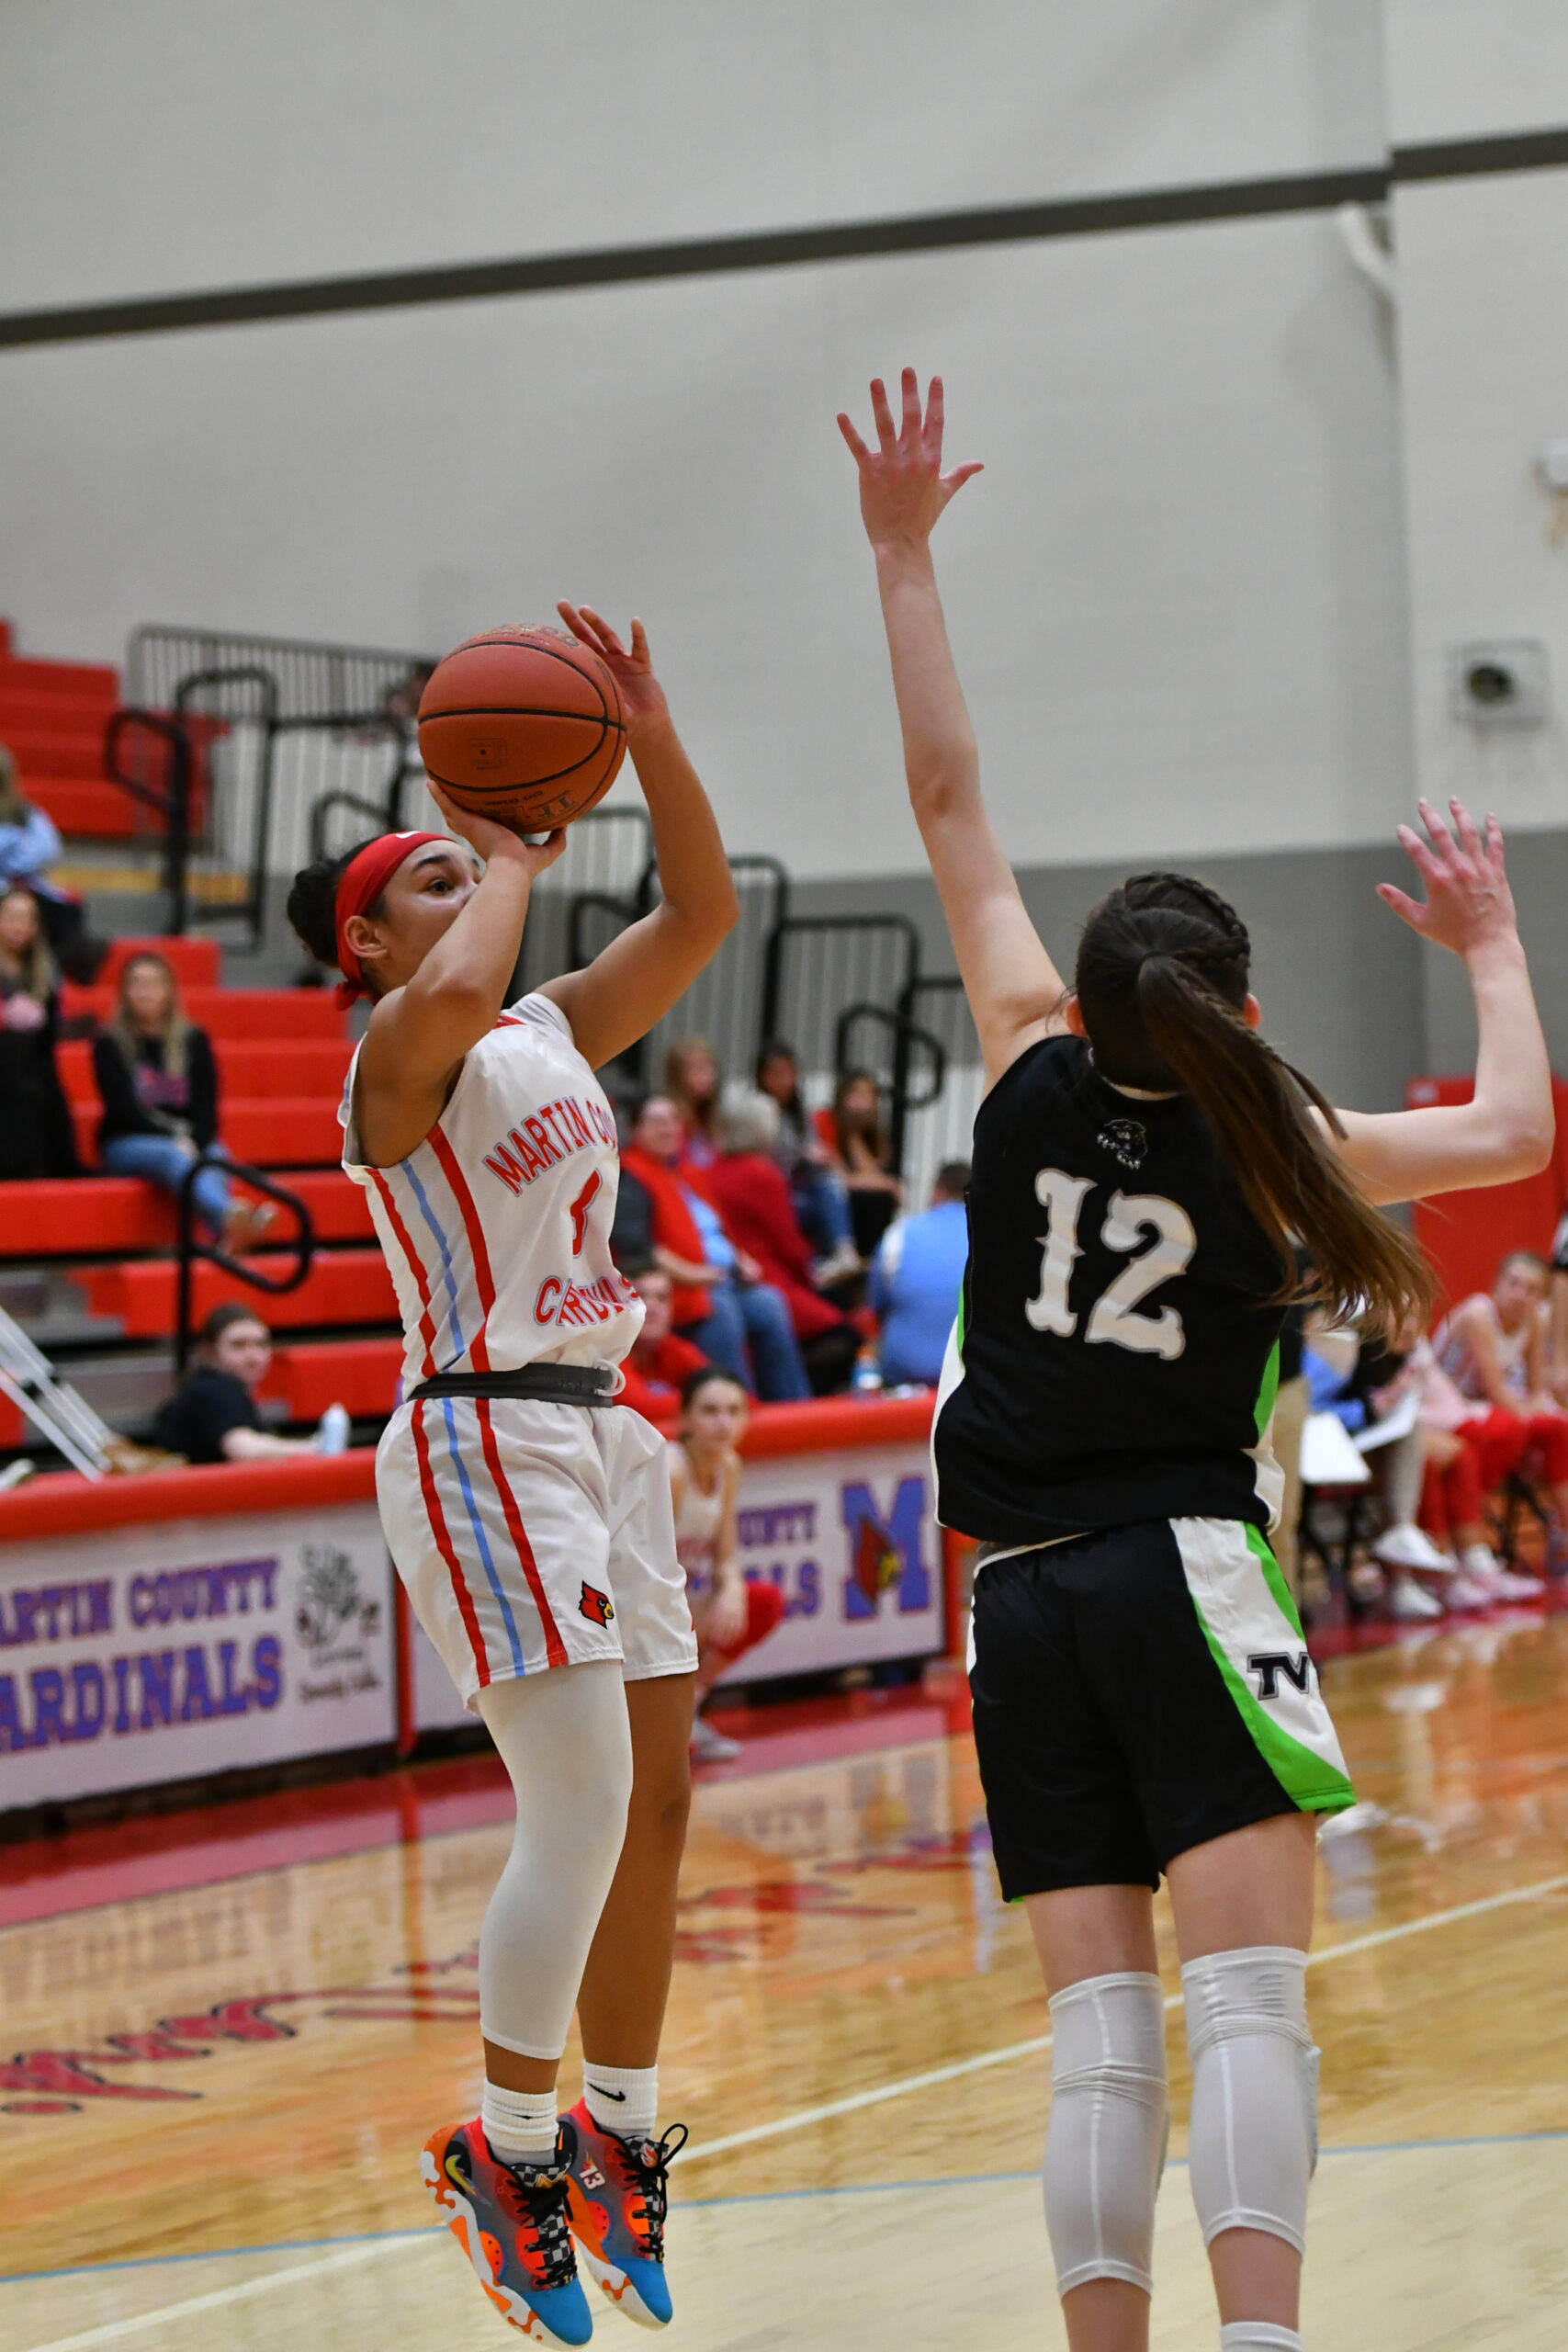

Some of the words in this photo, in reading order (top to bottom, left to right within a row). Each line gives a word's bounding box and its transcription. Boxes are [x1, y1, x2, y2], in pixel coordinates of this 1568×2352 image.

[483, 1095, 596, 1198] MARTIN
[1024, 1167, 1198, 1361] 12
[130, 1558, 279, 1628] COUNTY
[1247, 1651, 1311, 1701] TV
